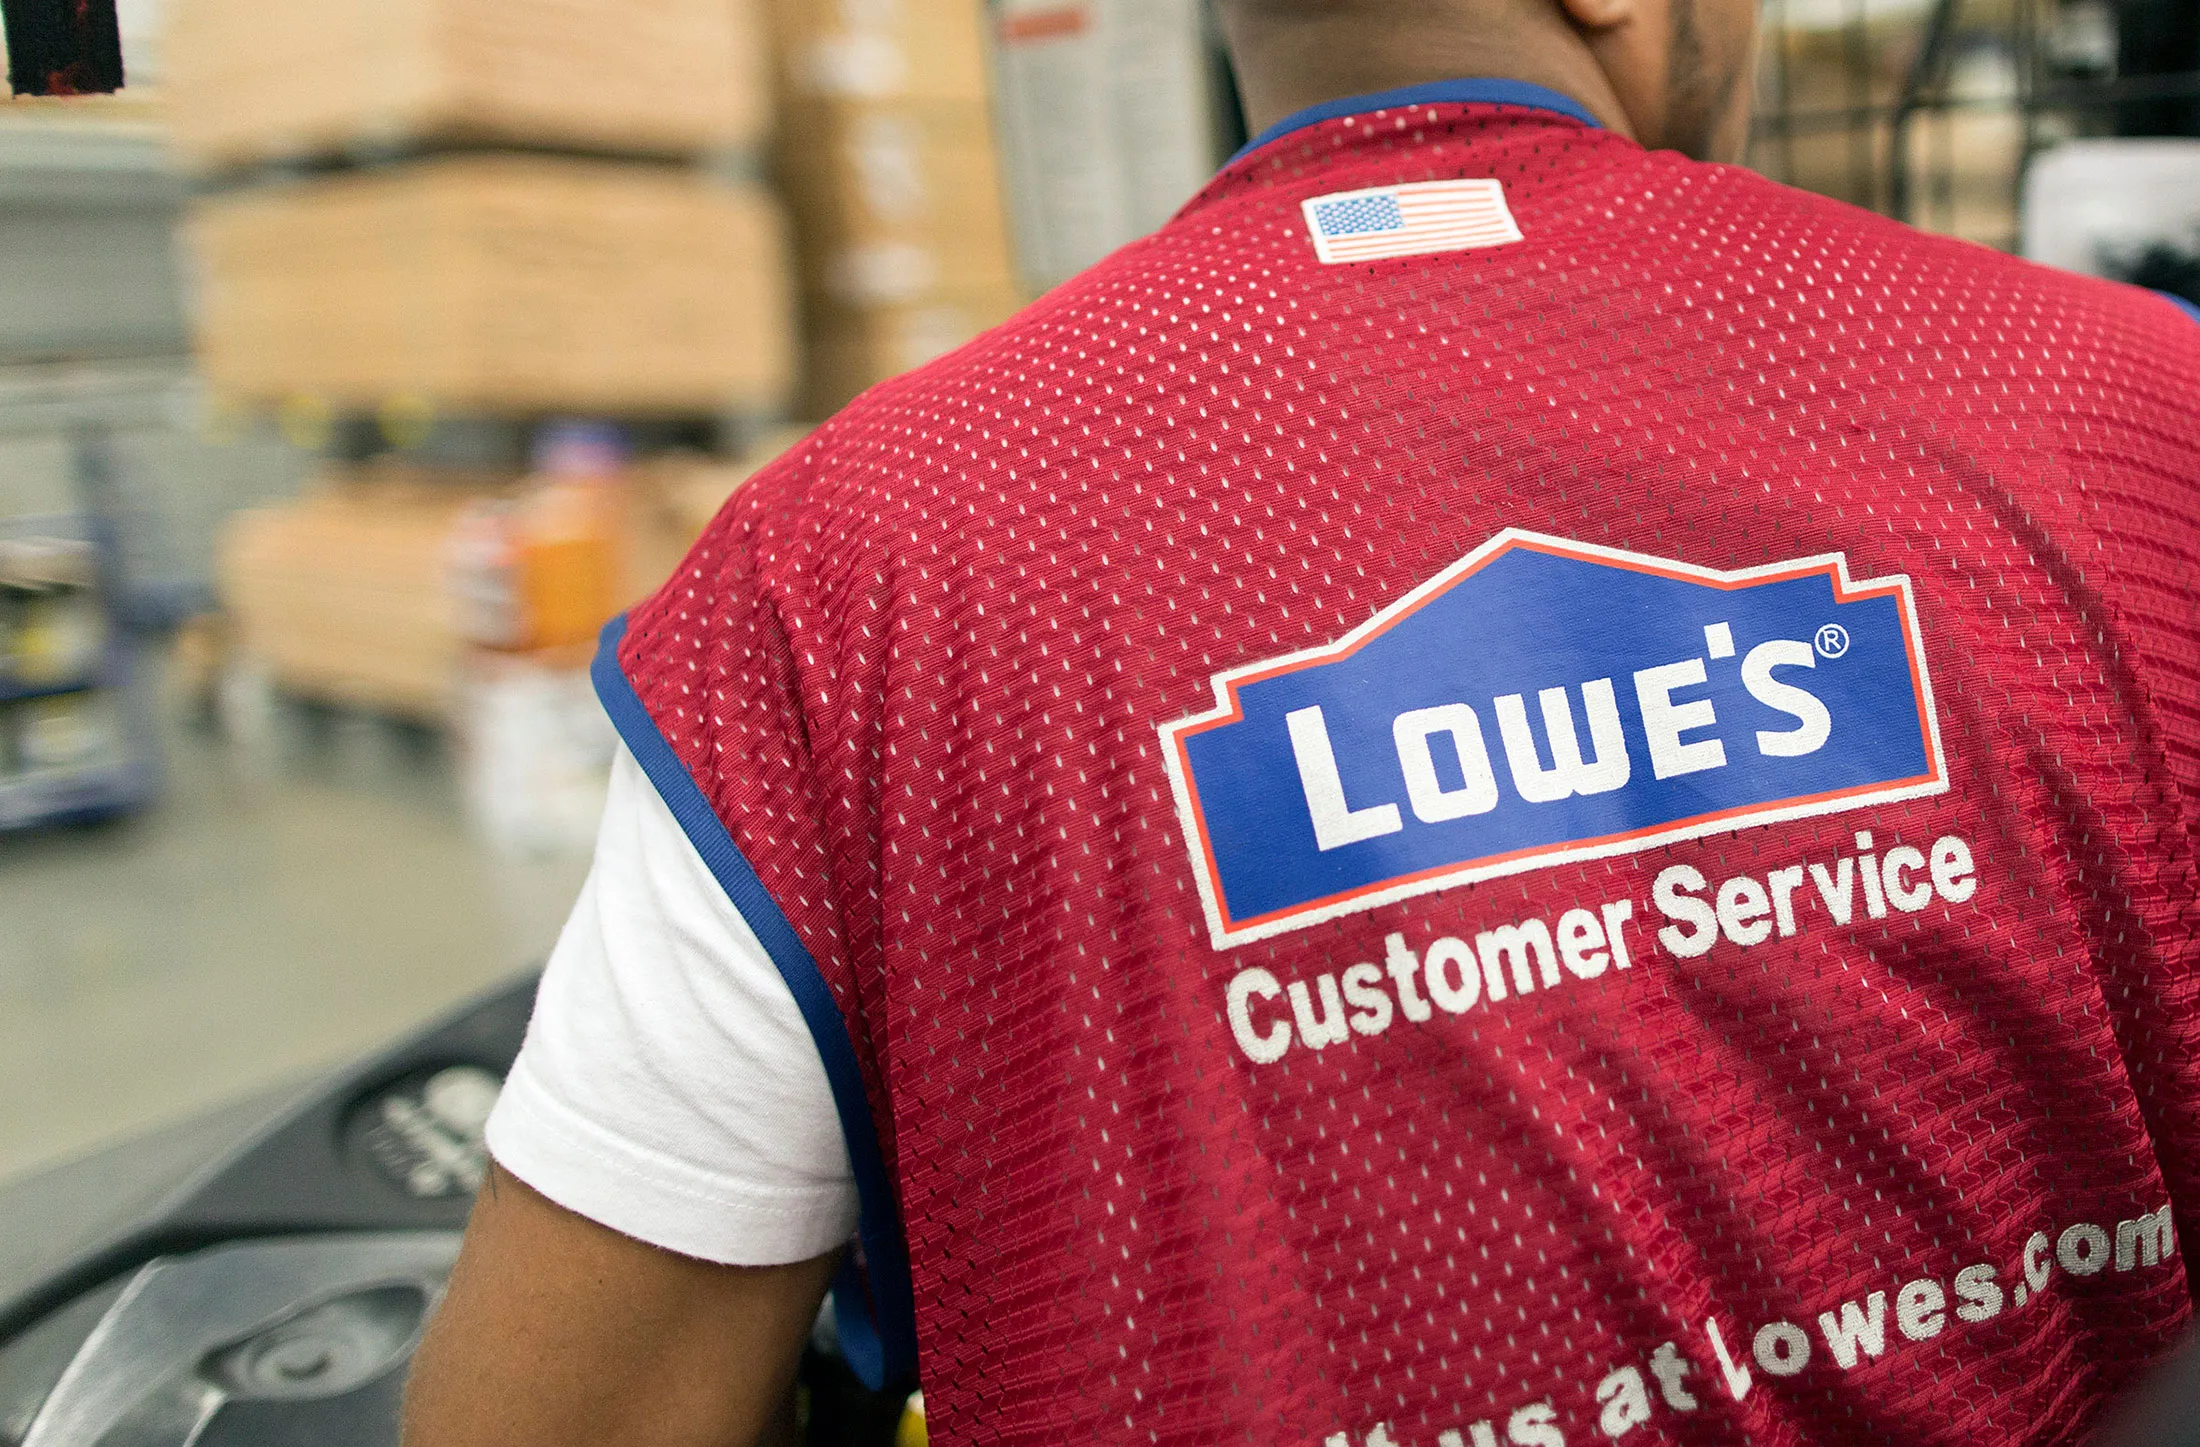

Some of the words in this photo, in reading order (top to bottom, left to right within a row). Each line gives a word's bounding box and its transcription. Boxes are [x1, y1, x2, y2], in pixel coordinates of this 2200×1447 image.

[1226, 899, 1633, 1064] Customer
[1652, 829, 1977, 959] Service
[1596, 1341, 1698, 1437] at
